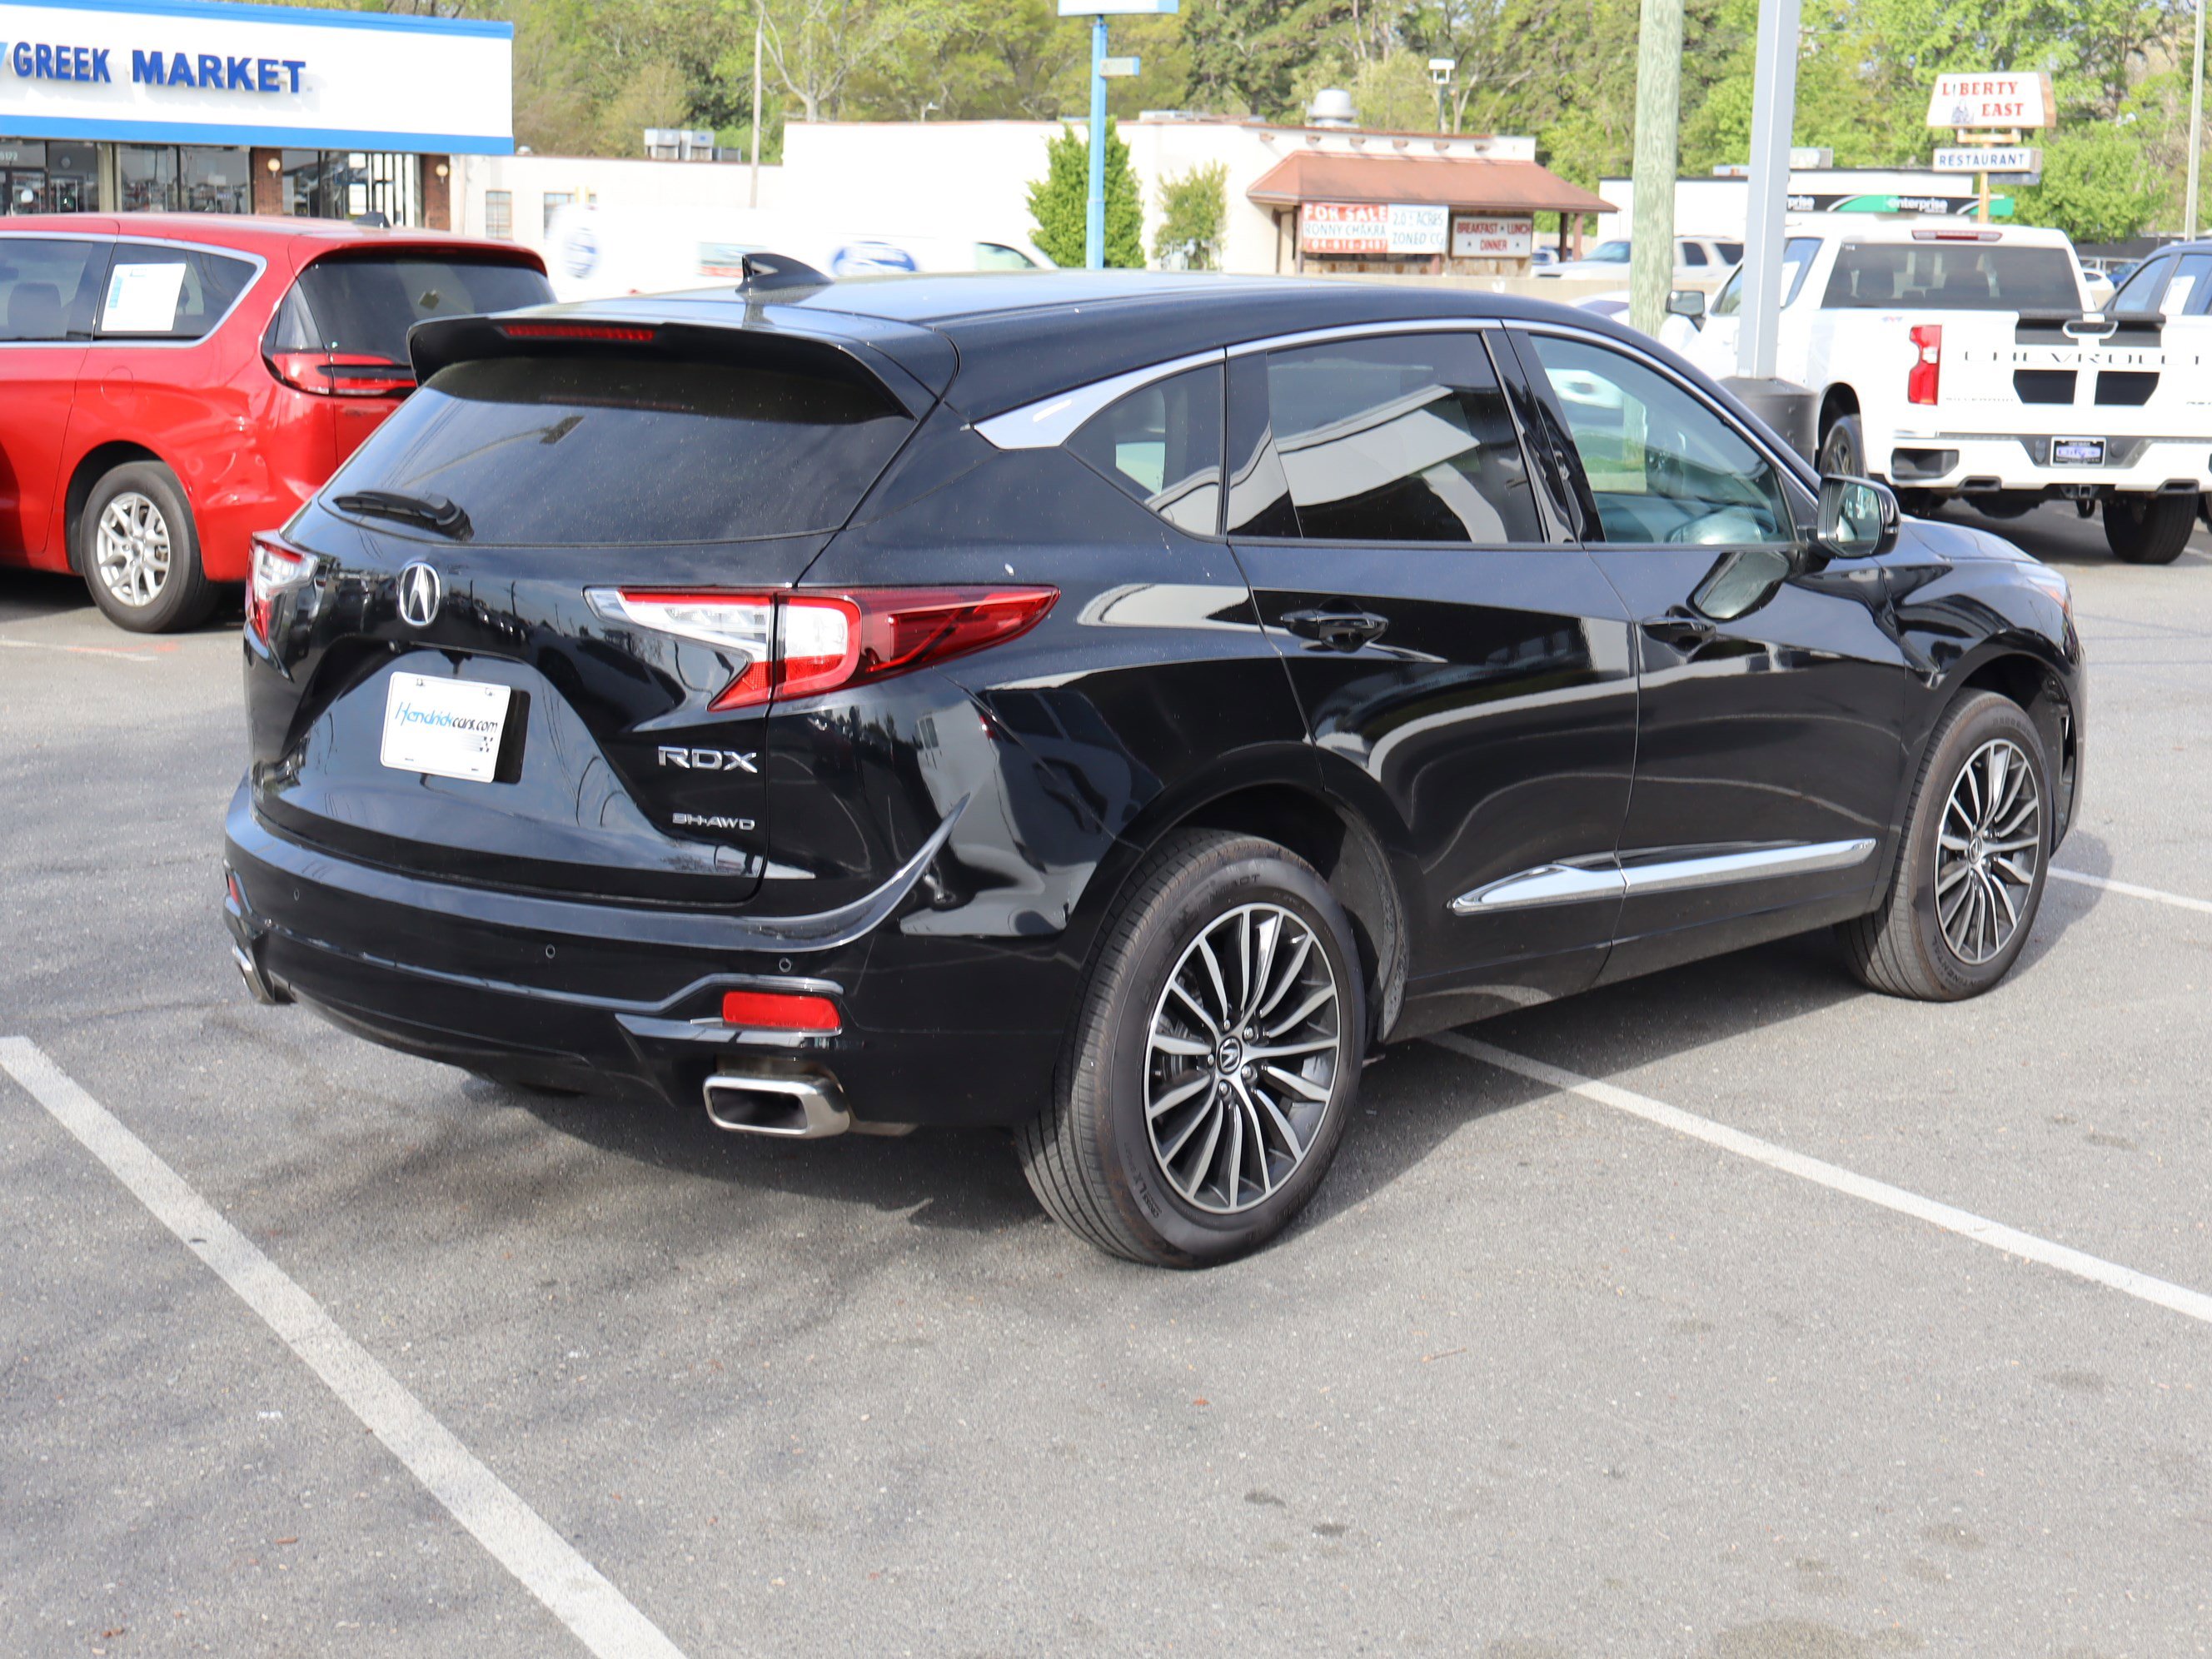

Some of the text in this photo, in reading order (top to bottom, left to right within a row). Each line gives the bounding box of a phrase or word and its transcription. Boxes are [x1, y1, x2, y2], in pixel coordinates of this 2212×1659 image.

[12, 42, 112, 83] GREEK
[132, 49, 306, 93] MARKET
[1942, 82, 2018, 96] LIBERTY
[1982, 102, 2024, 117] EAST
[1939, 153, 2025, 167] RESTAURANT
[1303, 203, 1387, 222] FOR SALE
[1416, 212, 1443, 227] ACRES
[1305, 223, 1342, 236] RONNY
[1457, 222, 1532, 234] BREAKFAST LUNCH
[1392, 232, 1426, 246] ZONED
[1480, 238, 1507, 251] DINNER
[658, 745, 758, 773] RDX
